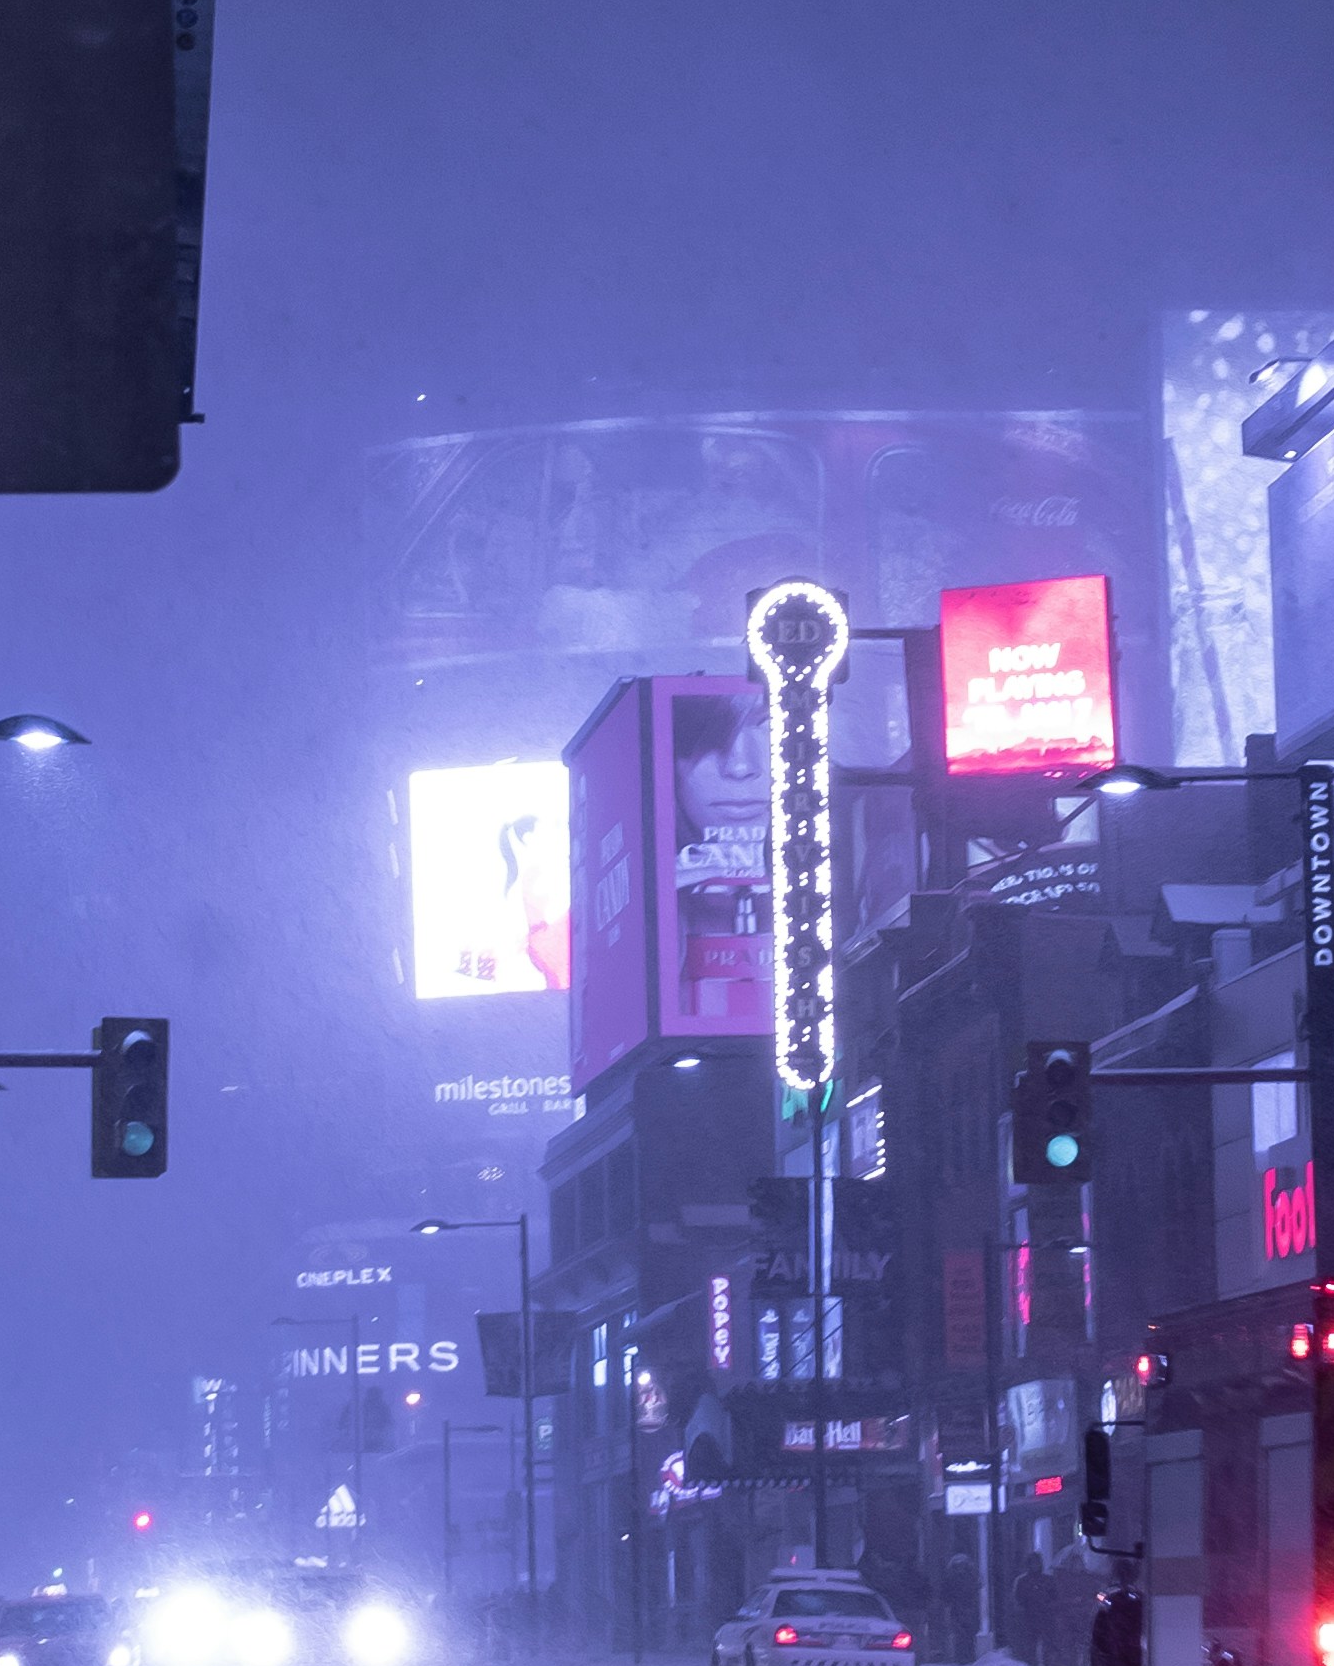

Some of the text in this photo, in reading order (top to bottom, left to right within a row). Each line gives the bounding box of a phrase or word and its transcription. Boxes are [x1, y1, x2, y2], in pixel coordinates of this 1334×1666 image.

[988, 642, 1062, 674] NOW
[967, 669, 1086, 704] PLAYING
[1308, 781, 1334, 967] DOWNTOWN
[434, 1074, 572, 1103] milestones
[296, 1266, 393, 1288] CINEPLEX
